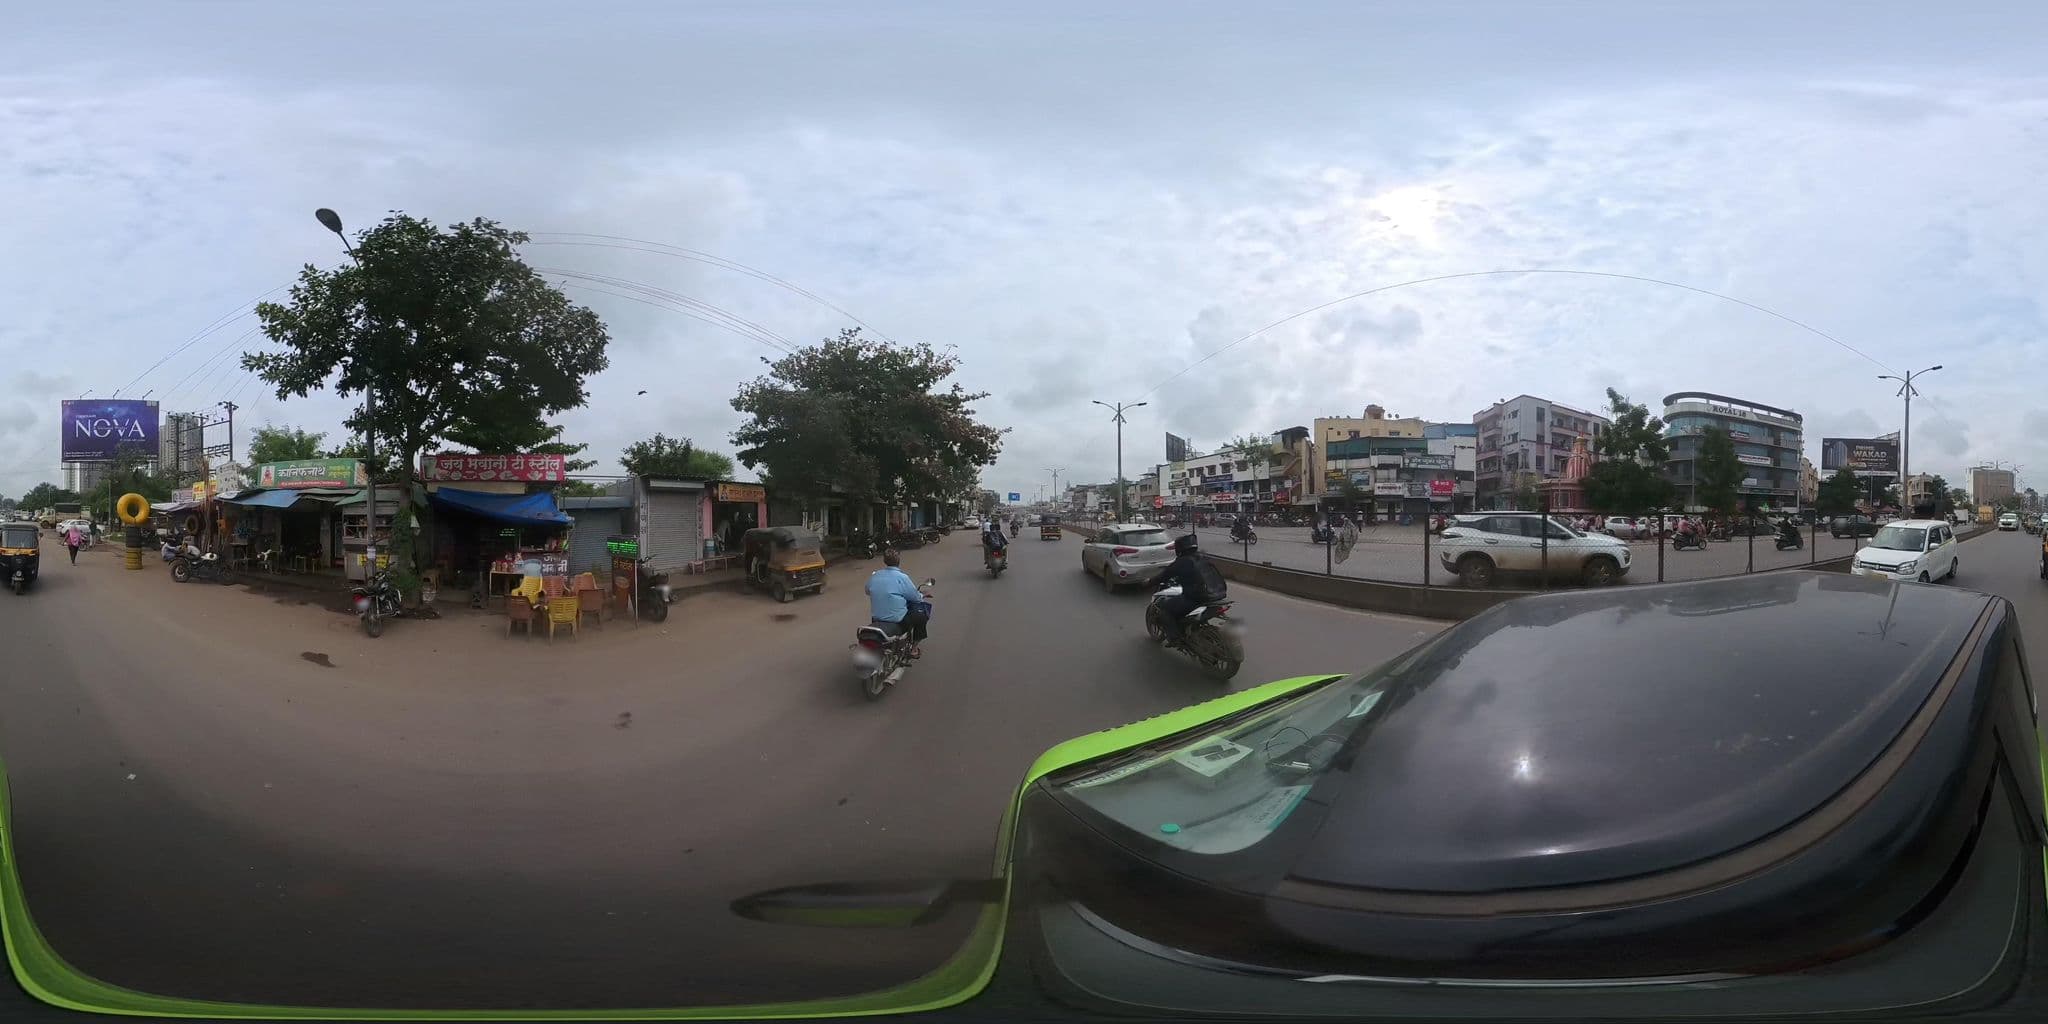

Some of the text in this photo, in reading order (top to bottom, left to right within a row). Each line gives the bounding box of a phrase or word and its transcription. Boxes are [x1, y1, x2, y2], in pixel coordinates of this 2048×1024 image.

[1712, 405, 1738, 415] ROYAL
[76, 418, 145, 438] NOVA
[1853, 450, 1887, 458] WAKAD
[440, 453, 560, 470] जय भवानी टी स्टॉल
